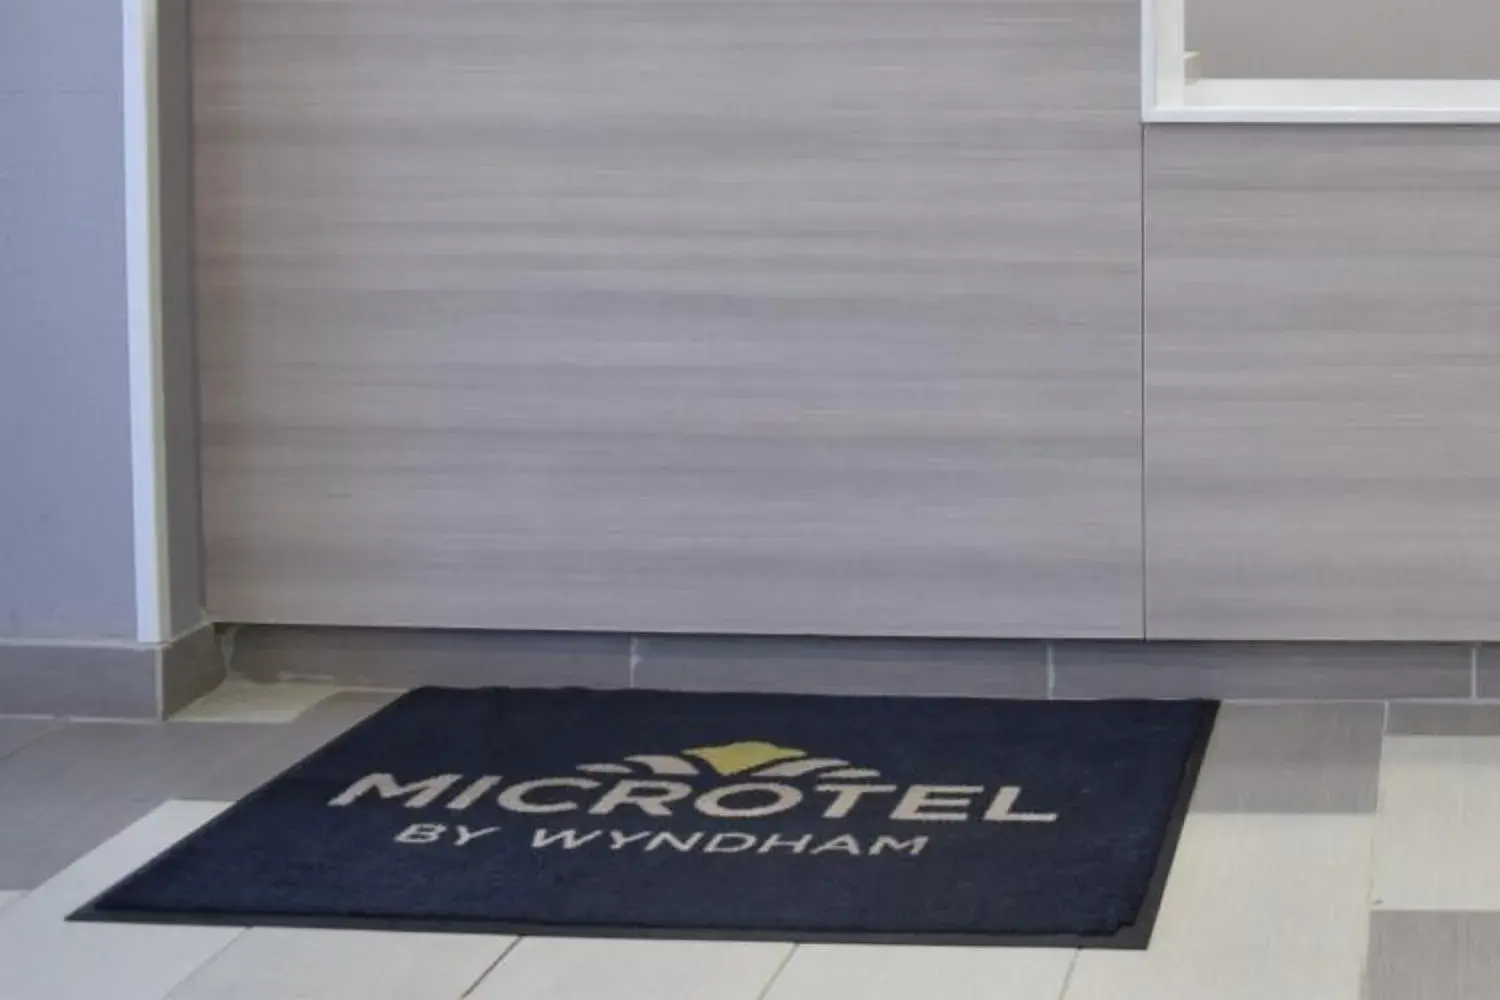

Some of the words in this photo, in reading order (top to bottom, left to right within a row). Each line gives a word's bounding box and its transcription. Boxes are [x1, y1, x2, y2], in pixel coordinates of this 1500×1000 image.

[328, 773, 1058, 822] MICROTEL
[394, 823, 499, 845] BY
[531, 828, 929, 856] WYNDHAM
